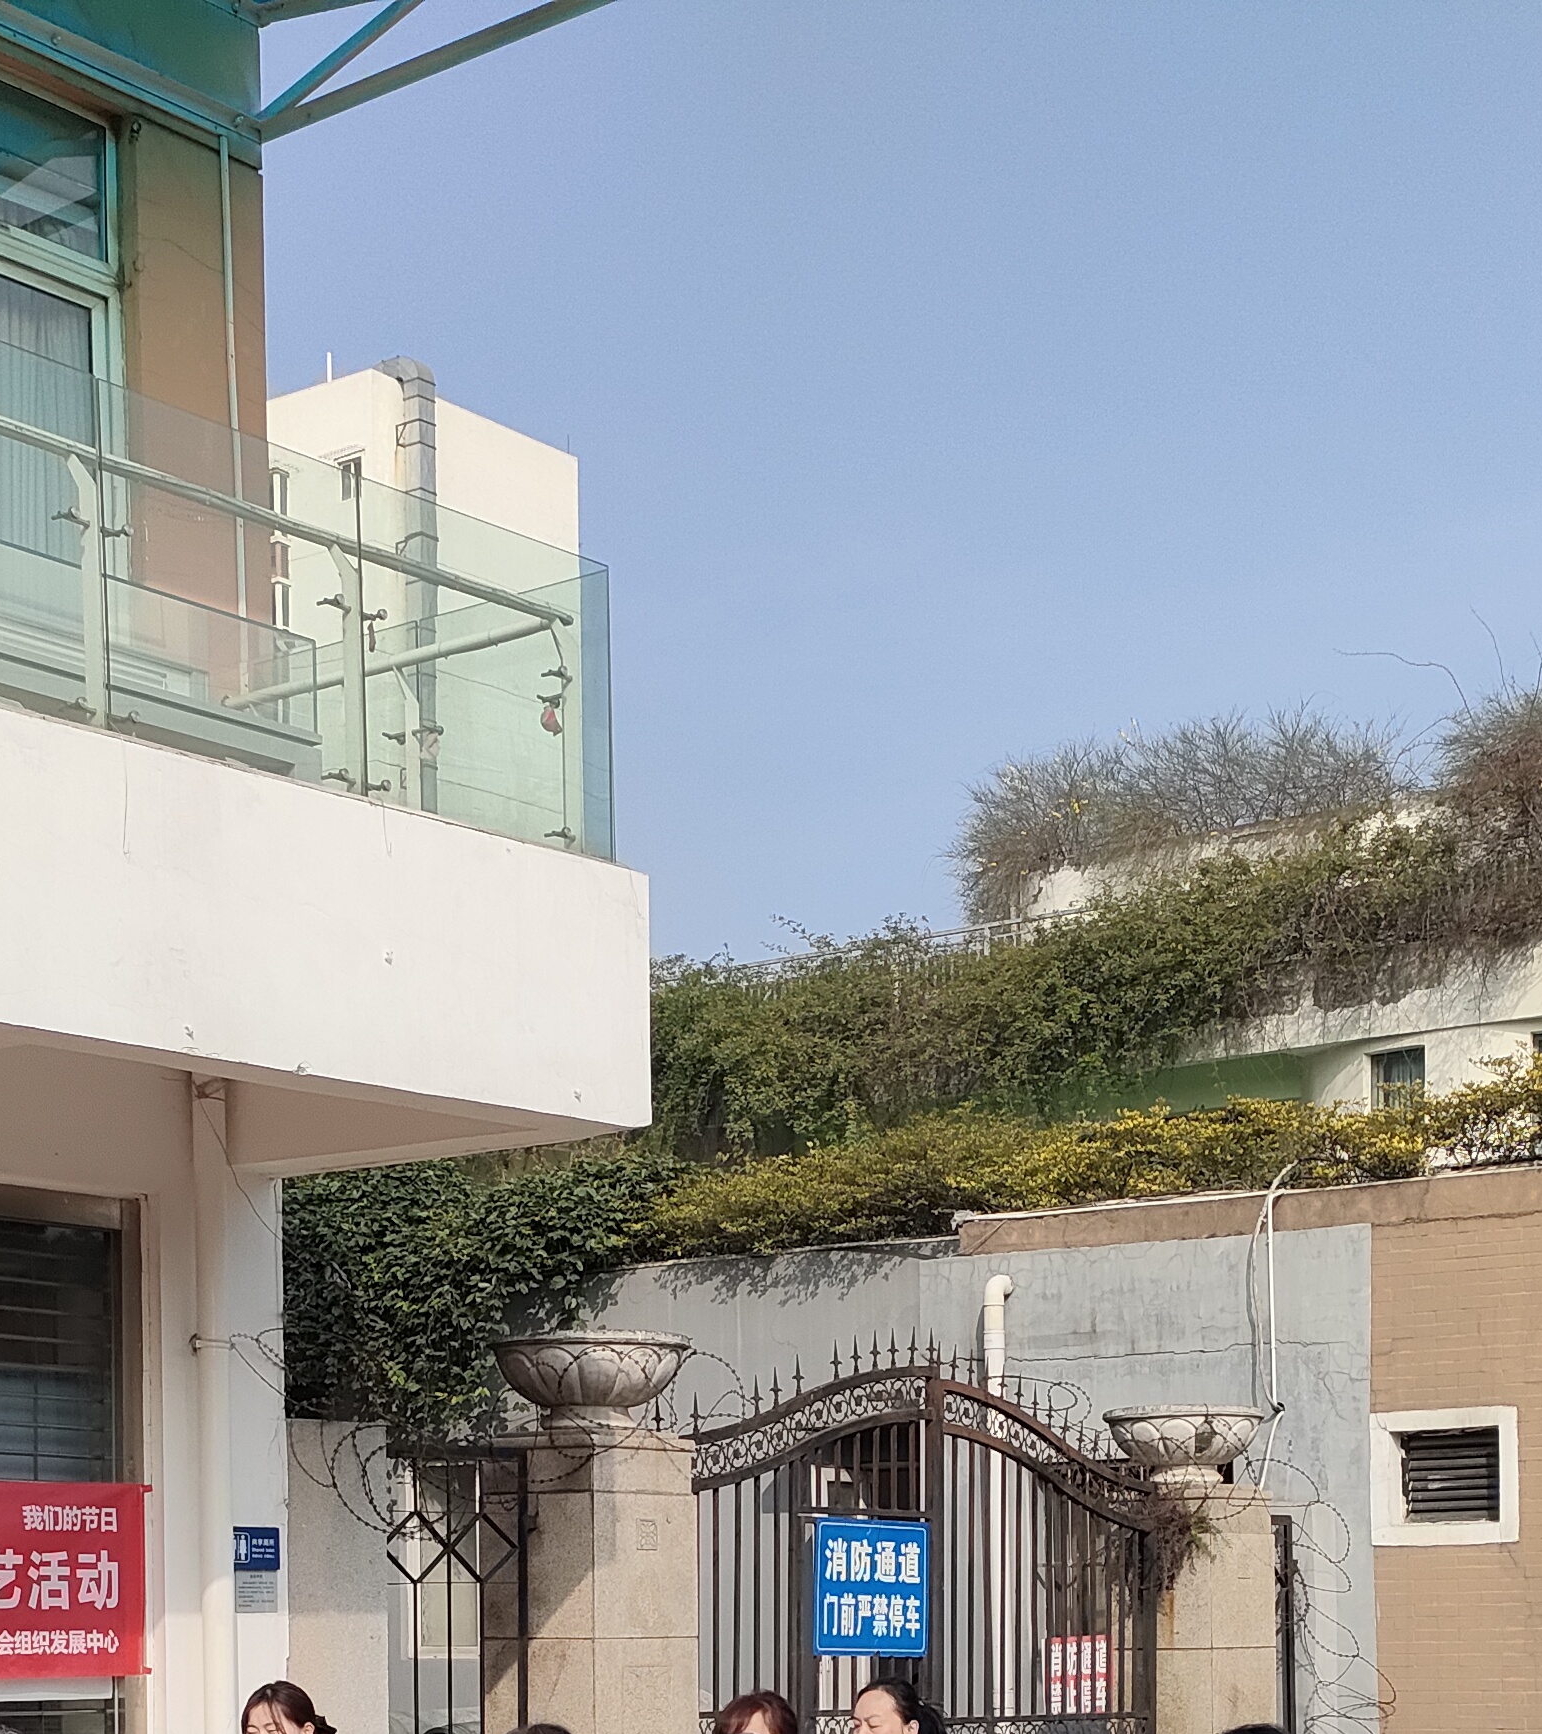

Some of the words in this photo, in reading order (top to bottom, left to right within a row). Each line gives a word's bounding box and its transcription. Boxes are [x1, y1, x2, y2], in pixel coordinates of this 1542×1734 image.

[22, 1504, 119, 1533] 我们的节日
[824, 1538, 921, 1585] 消防通道
[823, 1592, 921, 1638] 门前严禁停车
